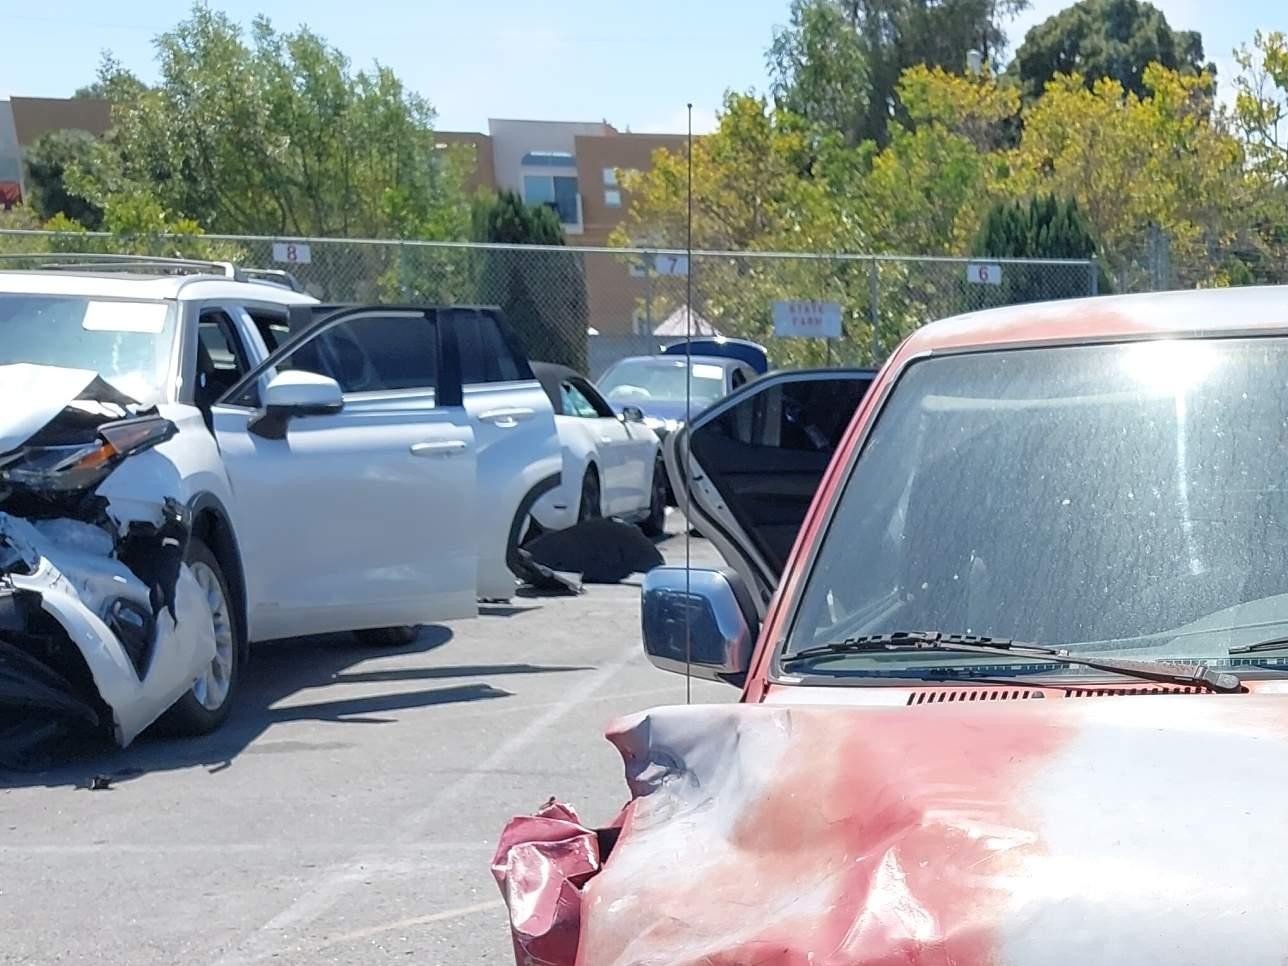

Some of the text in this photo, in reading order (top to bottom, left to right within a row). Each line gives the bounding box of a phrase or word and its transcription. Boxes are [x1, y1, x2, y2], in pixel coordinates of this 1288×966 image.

[287, 244, 297, 261] 8
[667, 256, 678, 273] 7
[979, 265, 989, 281] 6
